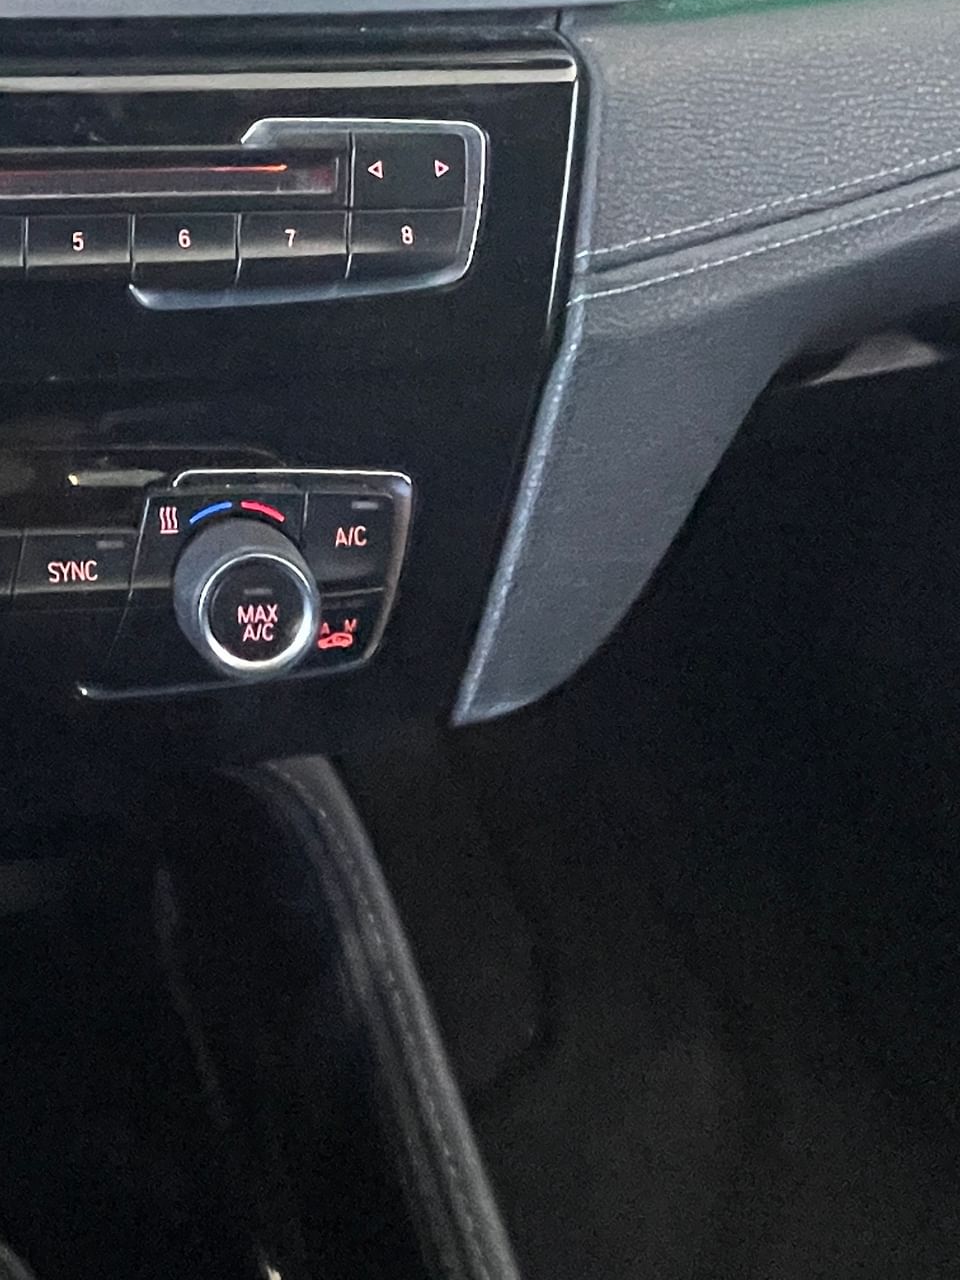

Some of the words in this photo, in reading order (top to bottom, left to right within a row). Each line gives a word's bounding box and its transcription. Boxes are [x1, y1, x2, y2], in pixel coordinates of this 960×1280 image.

[72, 231, 85, 252] 5
[178, 228, 191, 249] 6
[284, 227, 297, 248] 7
[401, 225, 414, 245] 8
[335, 525, 367, 548] A/C
[47, 560, 98, 583] SYNC
[237, 603, 279, 625] MAX
[242, 623, 275, 642] A/C
